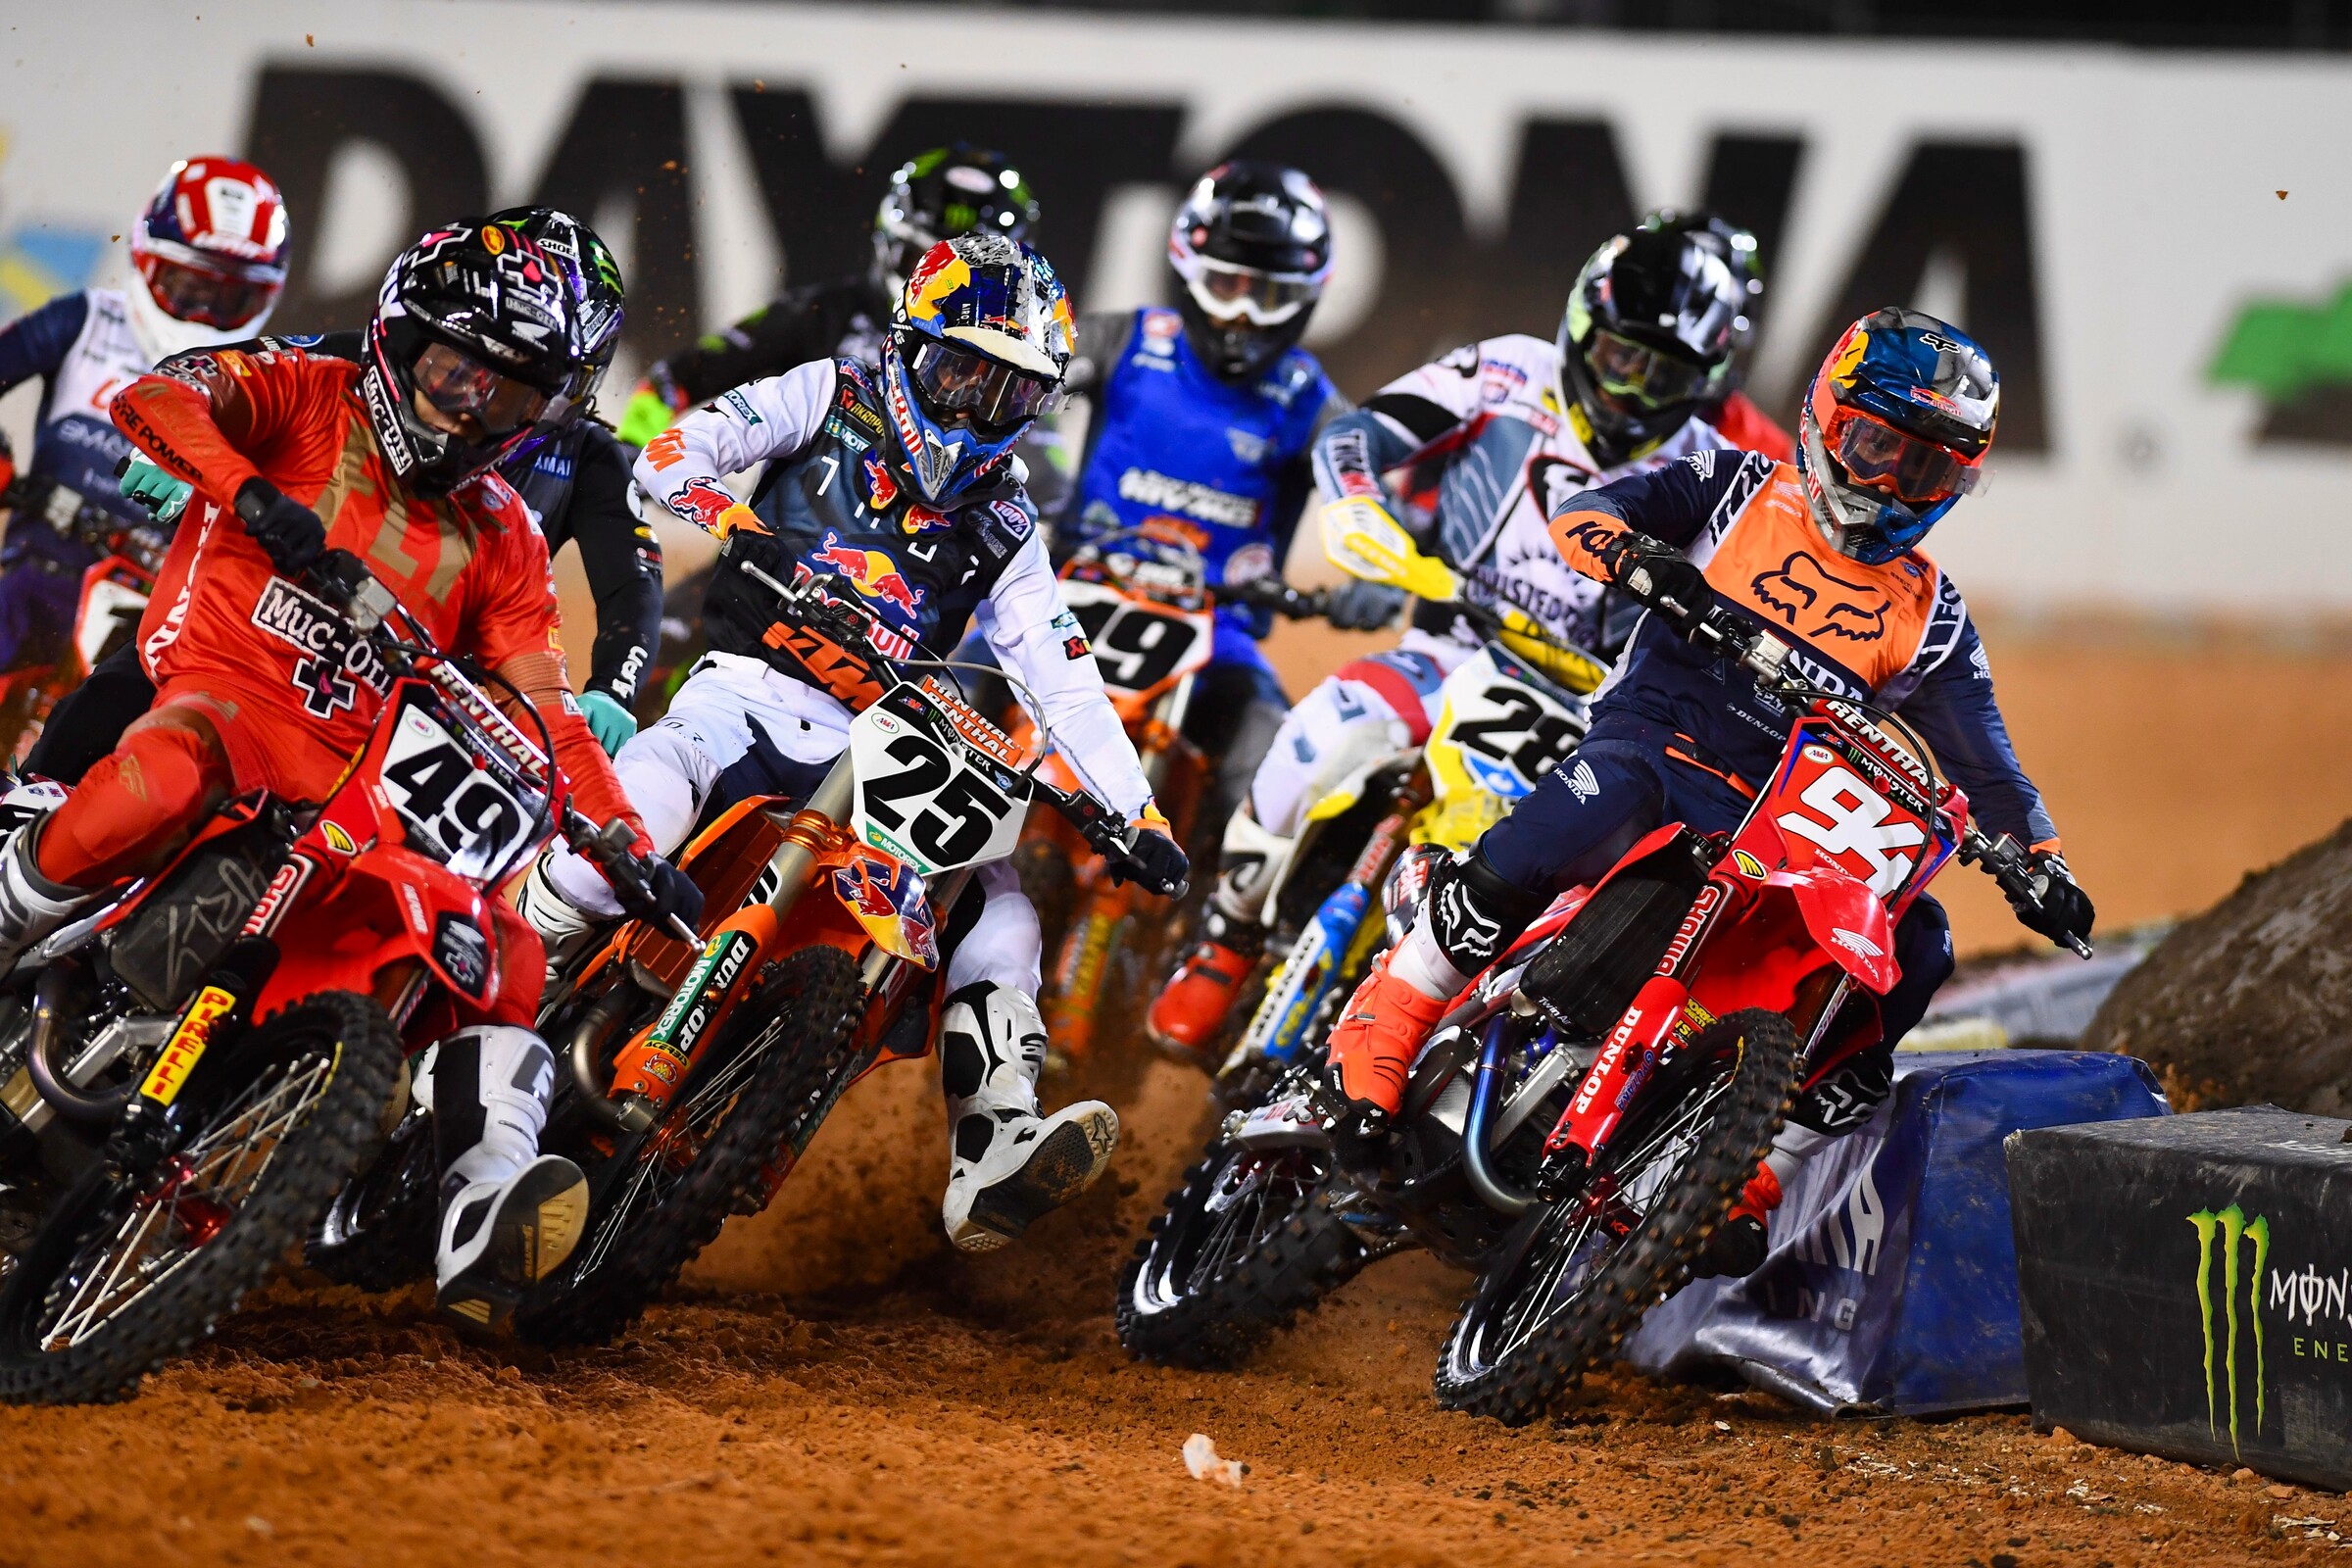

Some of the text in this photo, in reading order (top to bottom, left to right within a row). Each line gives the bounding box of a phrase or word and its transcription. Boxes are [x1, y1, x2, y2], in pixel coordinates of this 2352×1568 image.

[138, 425, 204, 482] POWER
[995, 502, 1028, 534] 100%
[761, 620, 886, 712] KTM
[430, 663, 549, 779] RENTHAL
[926, 689, 1010, 763] RENTHAL
[1449, 685, 1587, 784] 28
[1736, 709, 1788, 742] DUNLOP
[383, 741, 521, 877] 49
[862, 734, 1012, 868] 25
[1553, 766, 1588, 807] HONDA
[880, 837, 923, 873] MOTOREX
[1776, 765, 1930, 900] 94
[655, 957, 714, 1040] MOTOREX
[679, 935, 751, 1053] DUNOP
[1829, 935, 1882, 983] HONDA
[151, 992, 230, 1097] PIRELLI
[1539, 996, 1561, 1018] Twin
[1574, 1005, 1643, 1115] DUNLOP
[2269, 1262, 2352, 1331] MON
